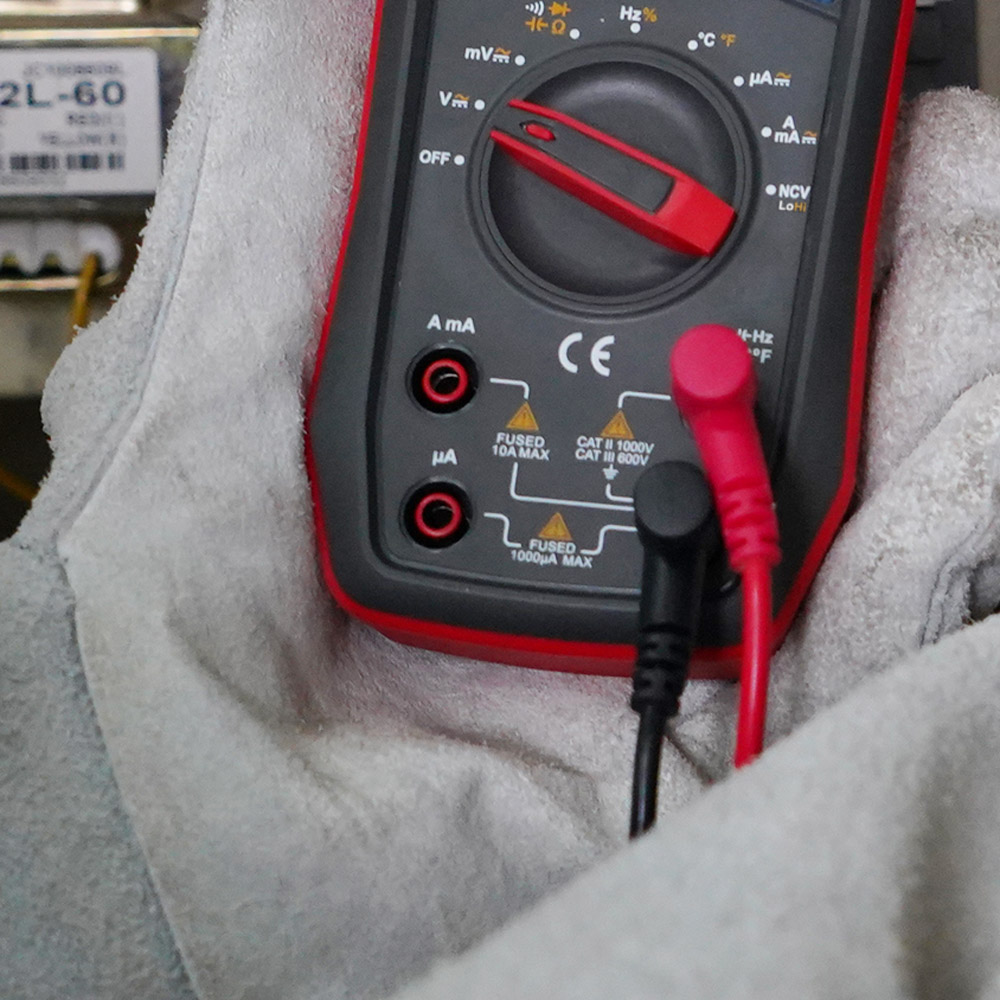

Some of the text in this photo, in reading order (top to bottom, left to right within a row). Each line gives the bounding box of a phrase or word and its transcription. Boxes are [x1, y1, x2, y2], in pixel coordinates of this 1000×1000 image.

[697, 31, 737, 48] °C °F
[782, 115, 796, 130] A
[419, 149, 451, 165] OFF
[778, 184, 812, 200] NCV
[426, 313, 476, 334] A mA
[557, 331, 616, 378] CE
[496, 432, 545, 448] FUSED
[576, 435, 655, 455] CAT II 1000V
[431, 448, 458, 466] µA
[492, 444, 551, 461] 10A MAX
[575, 448, 650, 466] CAT III 600V
[529, 539, 577, 554] FUSED
[510, 550, 593, 569] 1000µA MAX
